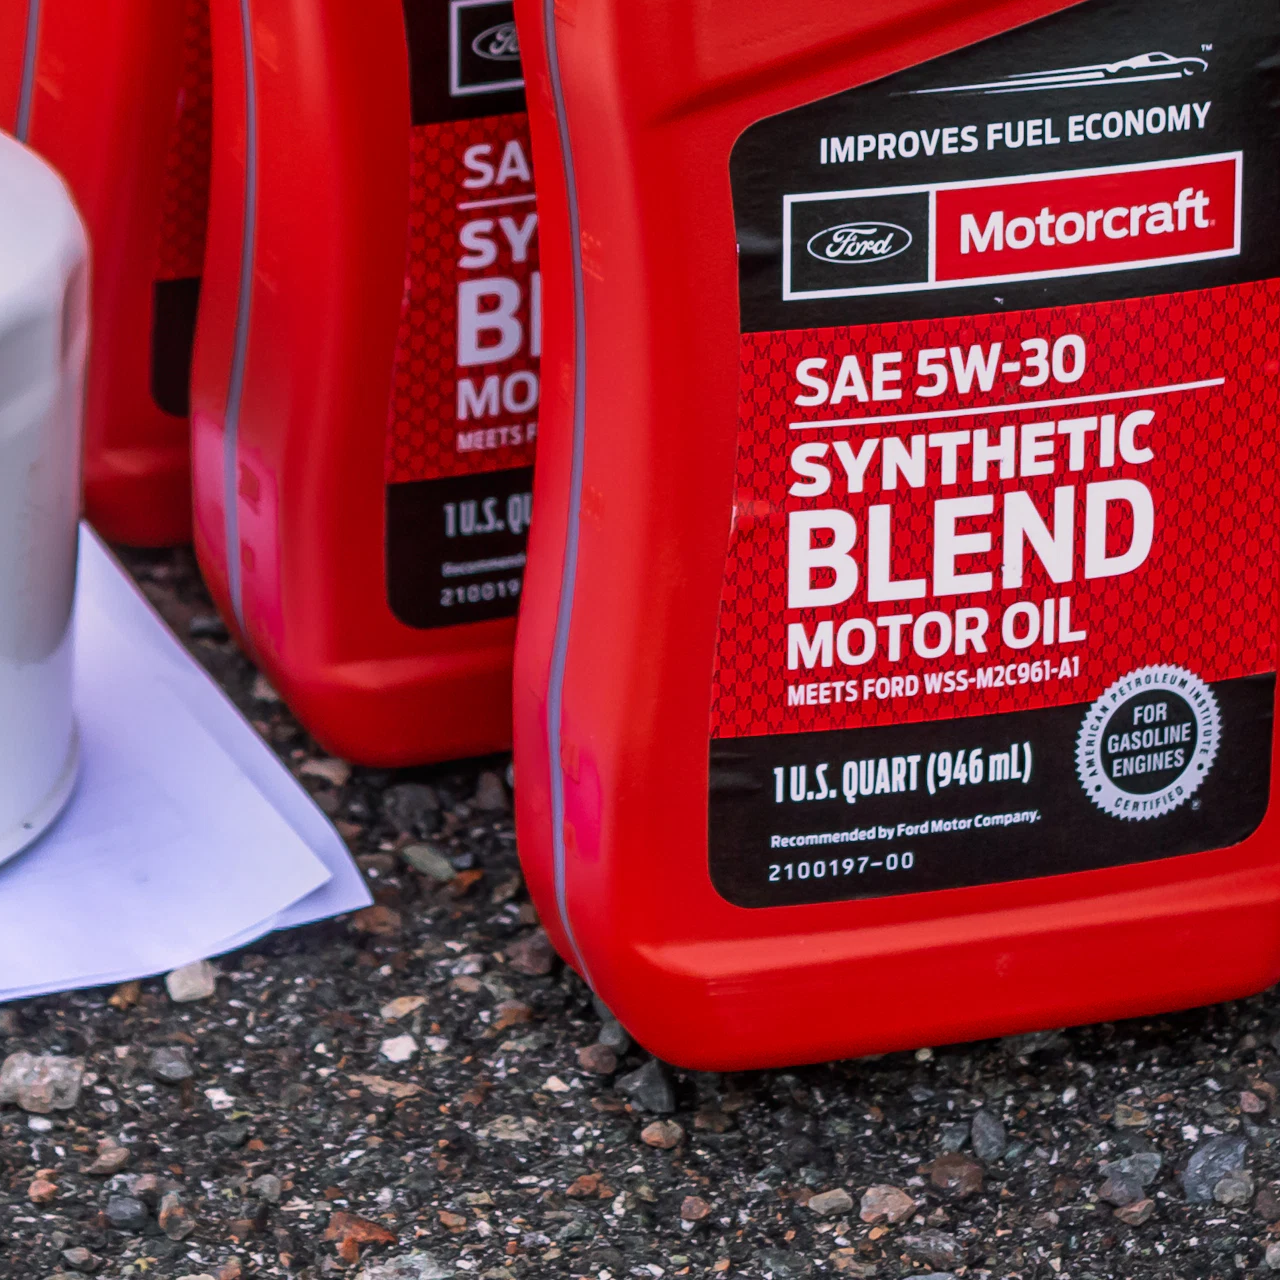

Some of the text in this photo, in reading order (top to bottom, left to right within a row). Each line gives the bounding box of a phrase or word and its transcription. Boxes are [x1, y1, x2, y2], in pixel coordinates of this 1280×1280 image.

[820, 101, 1212, 164] IMPROVES FUEL ECONOMY
[462, 139, 531, 189] SA
[825, 187, 1210, 259] Ford Motorcraft
[794, 334, 1087, 407] SAE 5W-30
[457, 425, 522, 453] MEETS
[788, 410, 1156, 497] SYNTHETIC
[443, 503, 457, 538] 1
[459, 497, 505, 536] U.S.
[787, 478, 1155, 609] BLEND
[440, 578, 521, 607] 210019
[787, 596, 1087, 671] MOTOR OIL
[787, 655, 1080, 707] MEETS FORD WSS-M2C961-A1
[1085, 673, 1213, 777] AMERICAN PETROLEUM INSTITUTE
[1107, 722, 1192, 754] GASOLINE
[1133, 702, 1168, 726] FOR
[773, 741, 1032, 804] 1 U.S. QUART (946 mL)
[1112, 748, 1185, 778] ENGINES
[1114, 785, 1184, 811] CERTIFIED
[770, 809, 1042, 849] Recommended by Ford Motor Company.
[769, 851, 914, 882] 2100197-00
